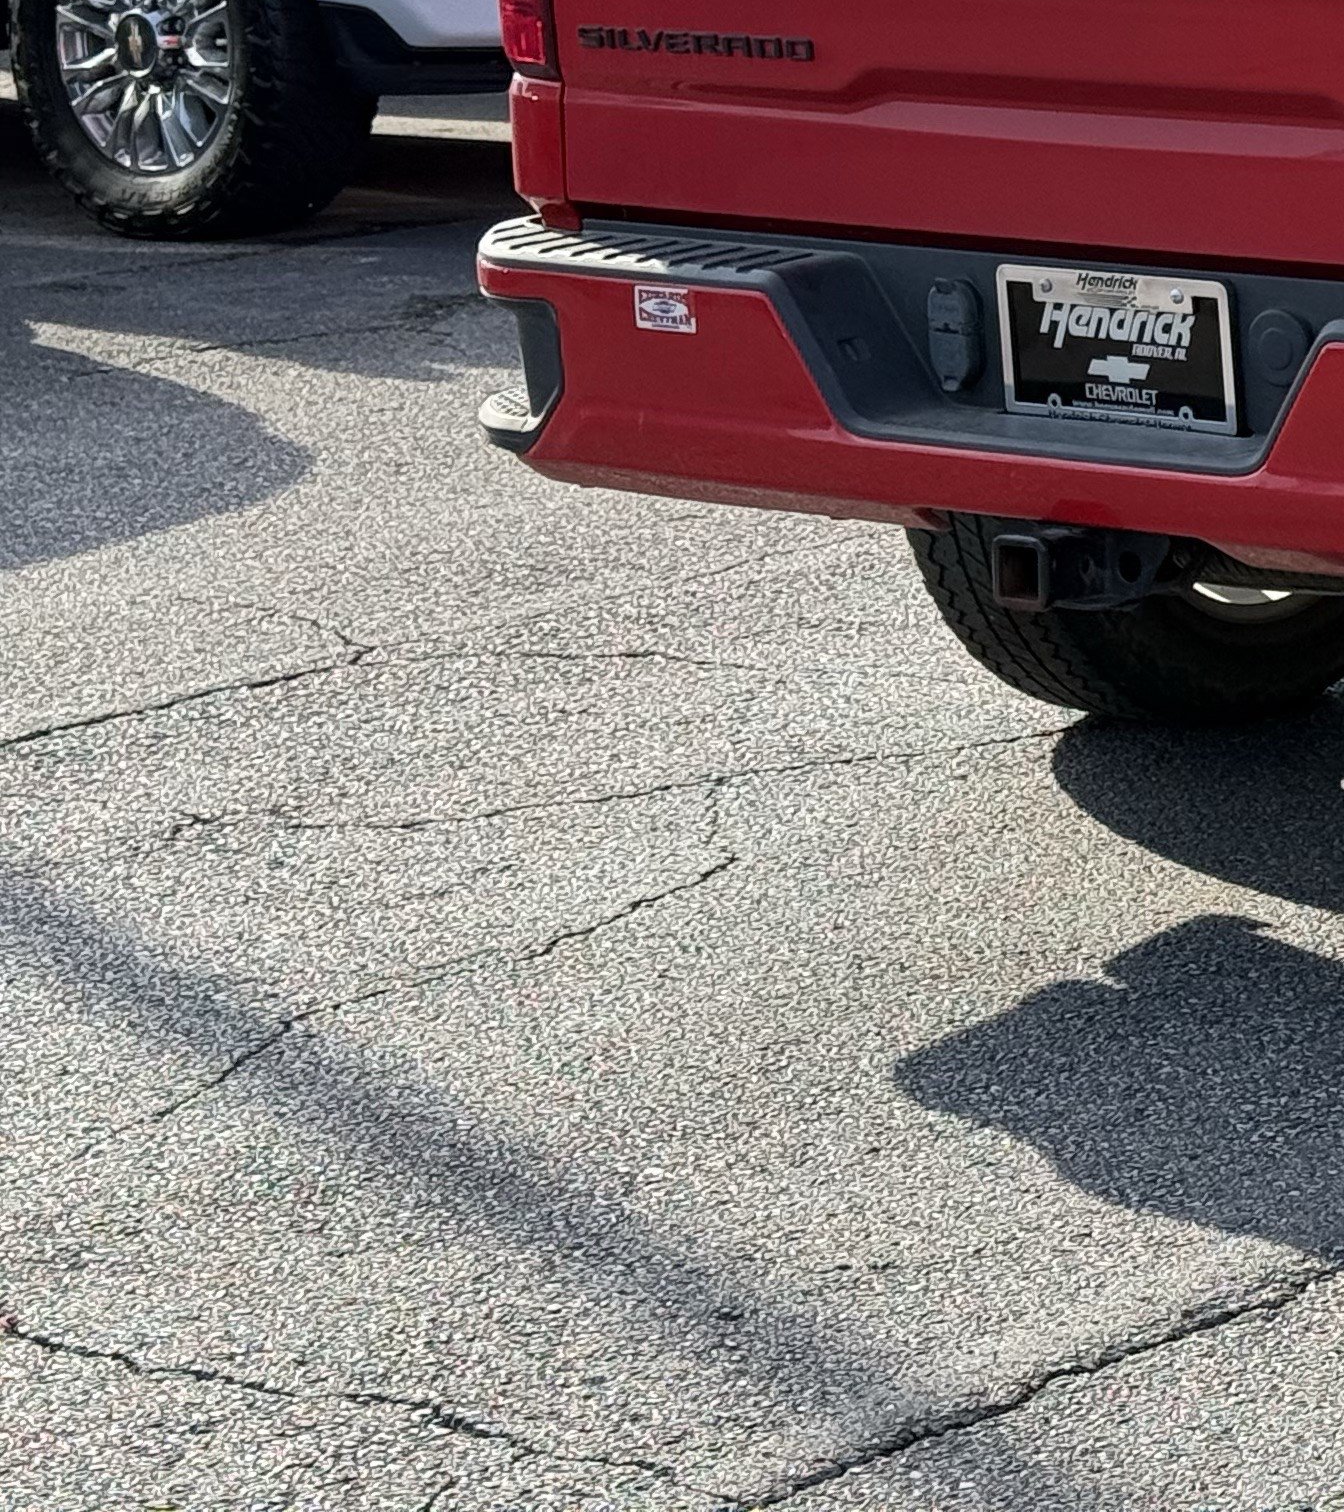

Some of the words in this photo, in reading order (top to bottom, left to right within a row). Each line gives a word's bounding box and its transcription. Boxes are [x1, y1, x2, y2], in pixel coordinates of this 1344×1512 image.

[577, 24, 815, 62] SILVERADO
[1075, 272, 1137, 291] Hendrick
[1039, 302, 1196, 349] Hendrick
[1084, 382, 1159, 406] CHEVROLET
